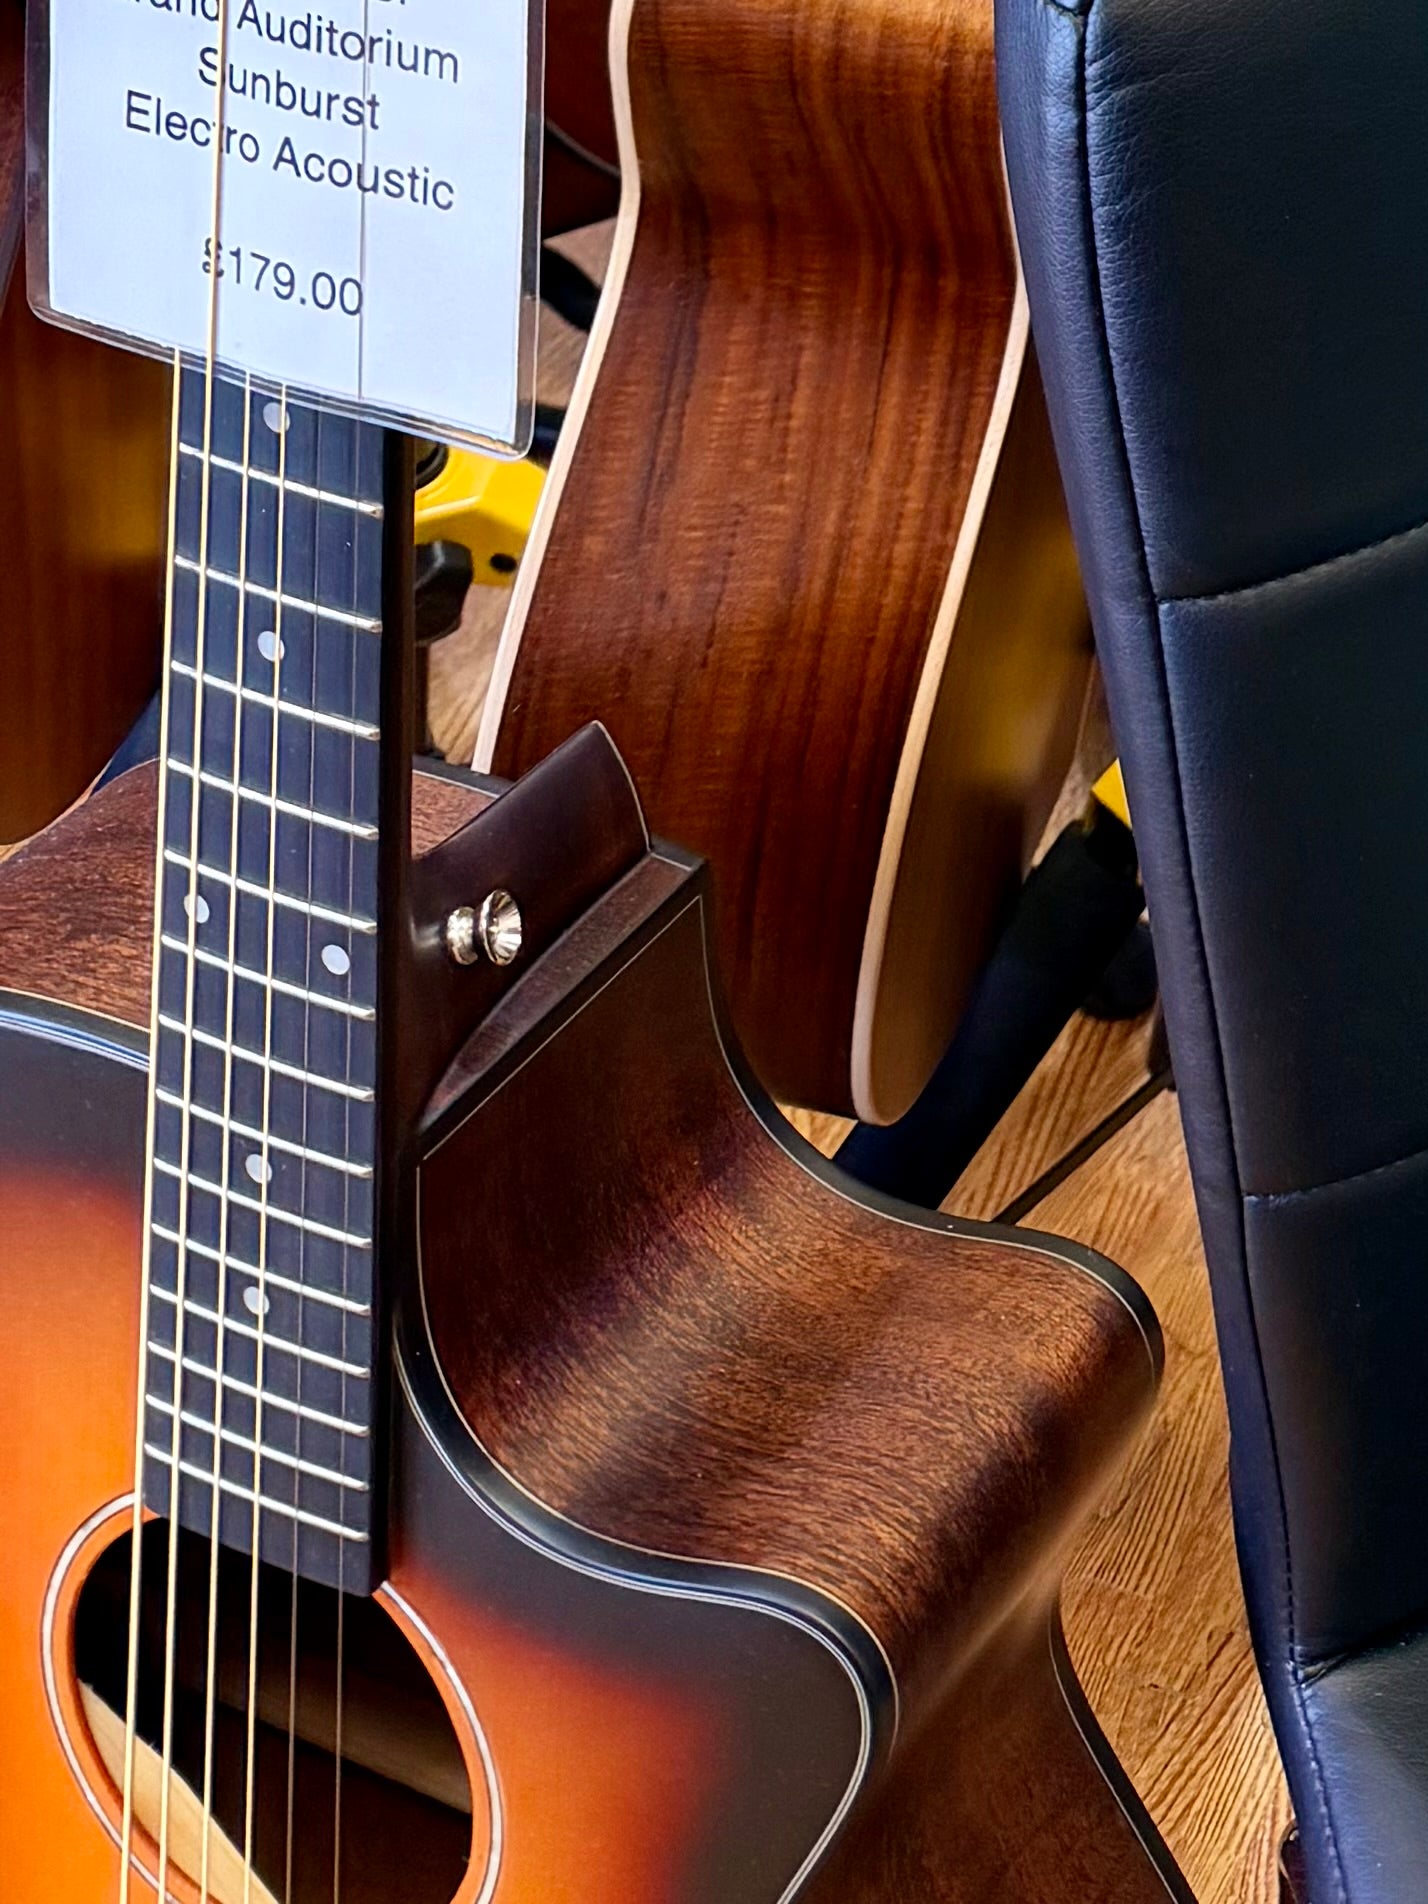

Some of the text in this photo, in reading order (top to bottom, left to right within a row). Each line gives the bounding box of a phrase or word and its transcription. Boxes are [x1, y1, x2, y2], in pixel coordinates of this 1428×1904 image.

[198, 47, 381, 132] Sunburst
[126, 90, 456, 213] Elecro Acoustic
[203, 237, 365, 317] £179.00
